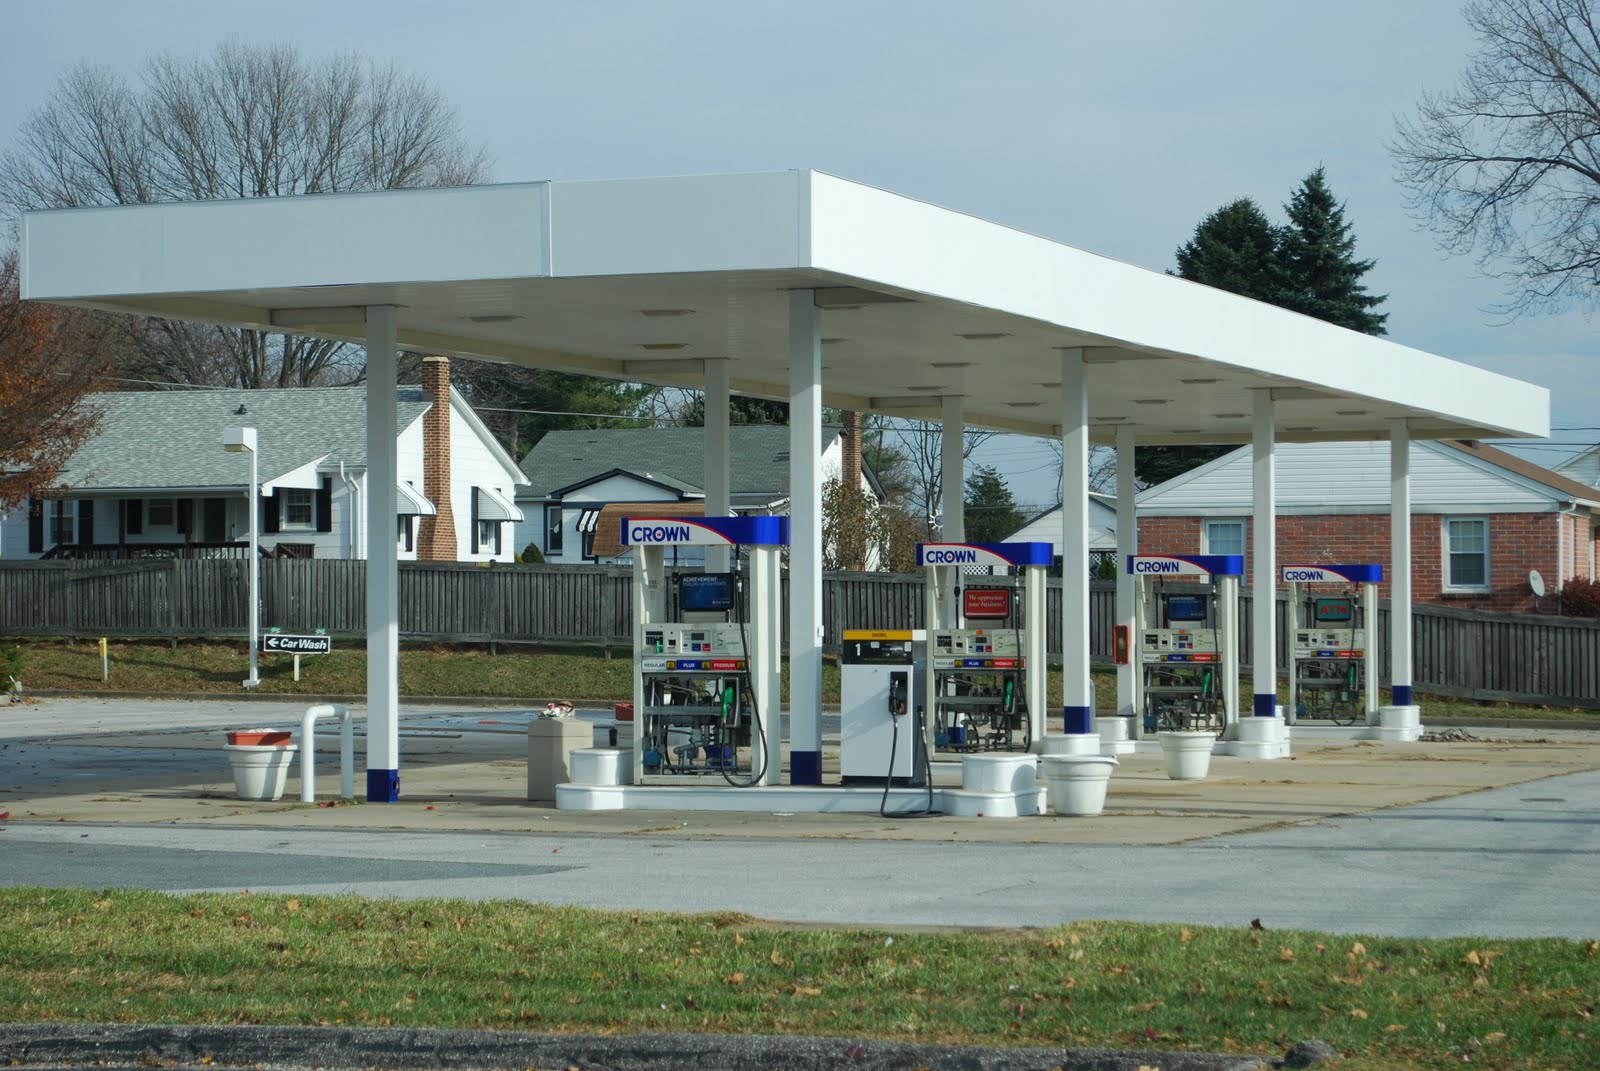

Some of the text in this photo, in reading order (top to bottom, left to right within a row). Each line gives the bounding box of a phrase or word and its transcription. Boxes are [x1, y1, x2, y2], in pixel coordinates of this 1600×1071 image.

[632, 526, 690, 542] CROWN
[926, 550, 976, 563] CROWN
[1136, 561, 1179, 572] CROWN
[1285, 571, 1323, 580] CROWN
[1320, 605, 1348, 614] ATM
[280, 638, 327, 649] Car Wash
[855, 643, 861, 656] 1
